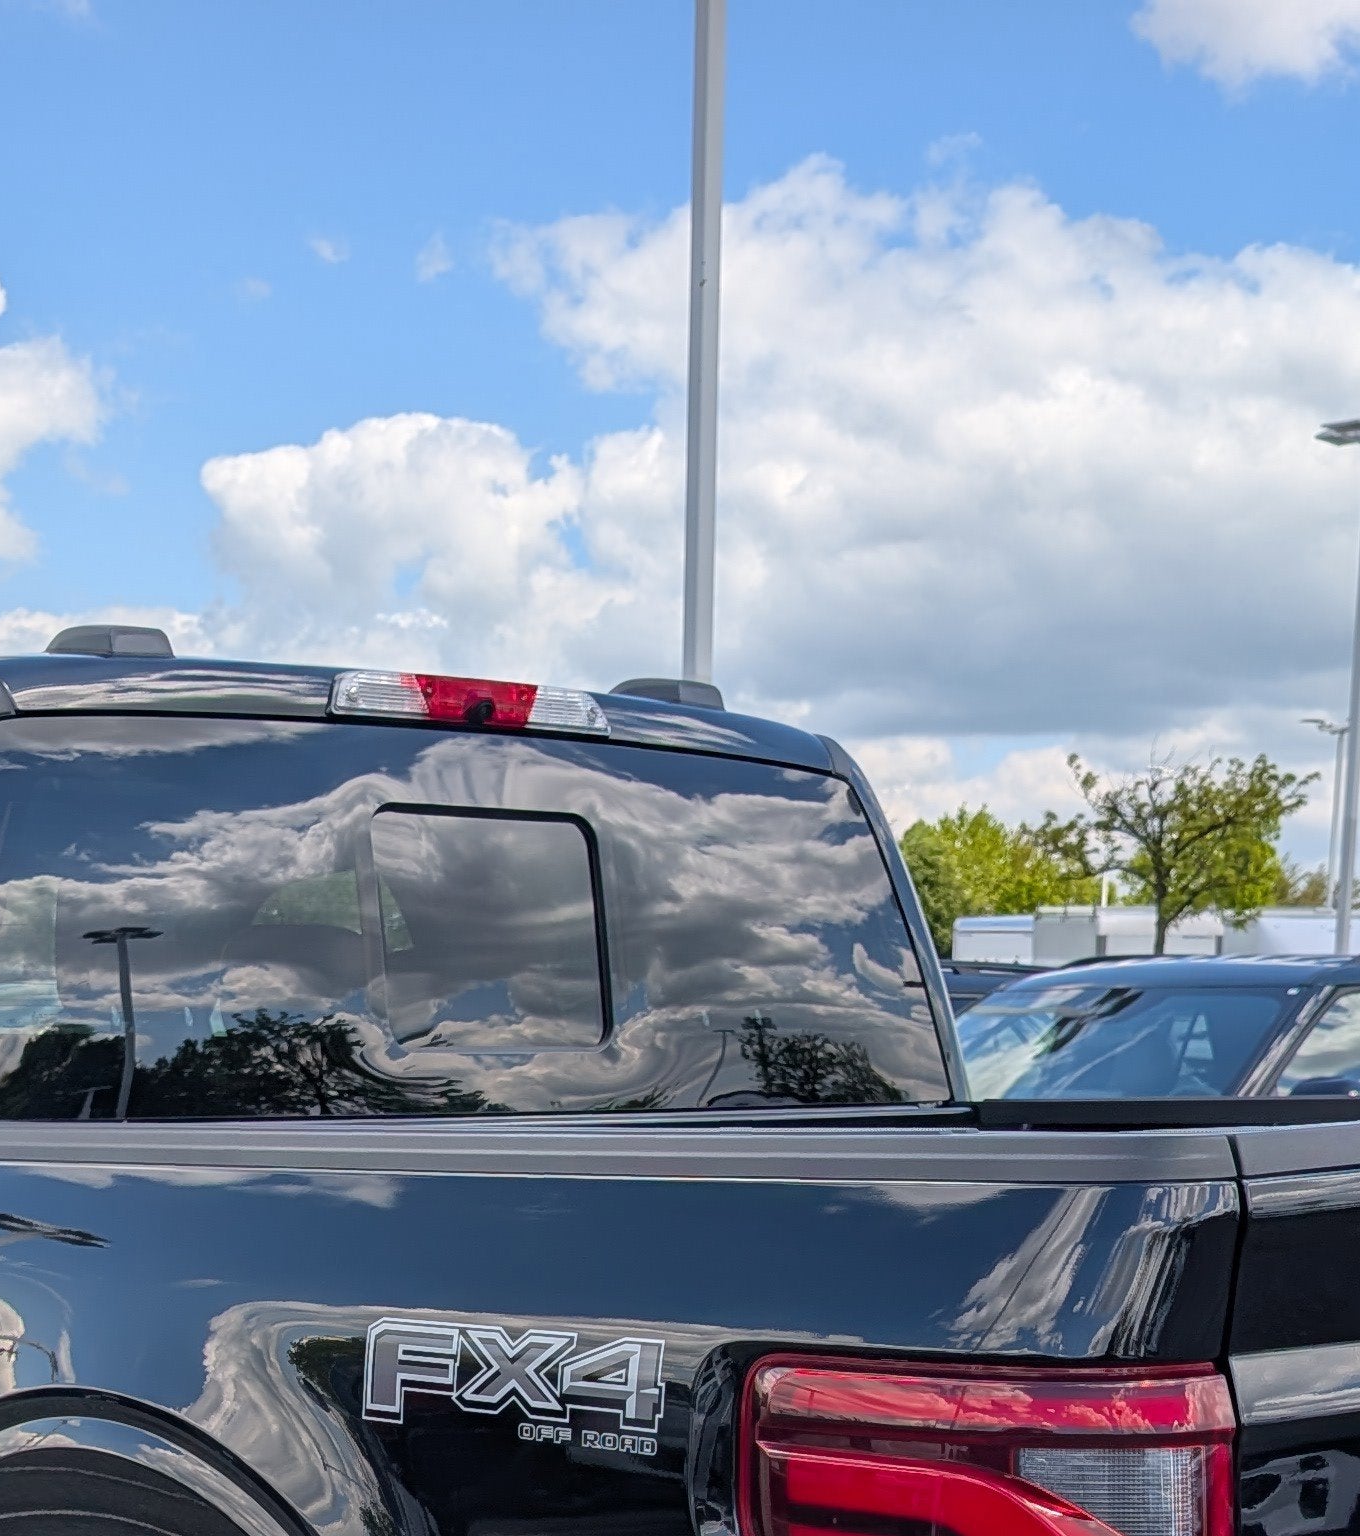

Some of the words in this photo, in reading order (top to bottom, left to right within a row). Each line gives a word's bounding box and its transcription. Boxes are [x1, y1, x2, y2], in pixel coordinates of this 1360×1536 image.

[362, 1316, 666, 1433] FX4
[517, 1422, 572, 1444] OFF
[581, 1429, 658, 1456] ROAD
